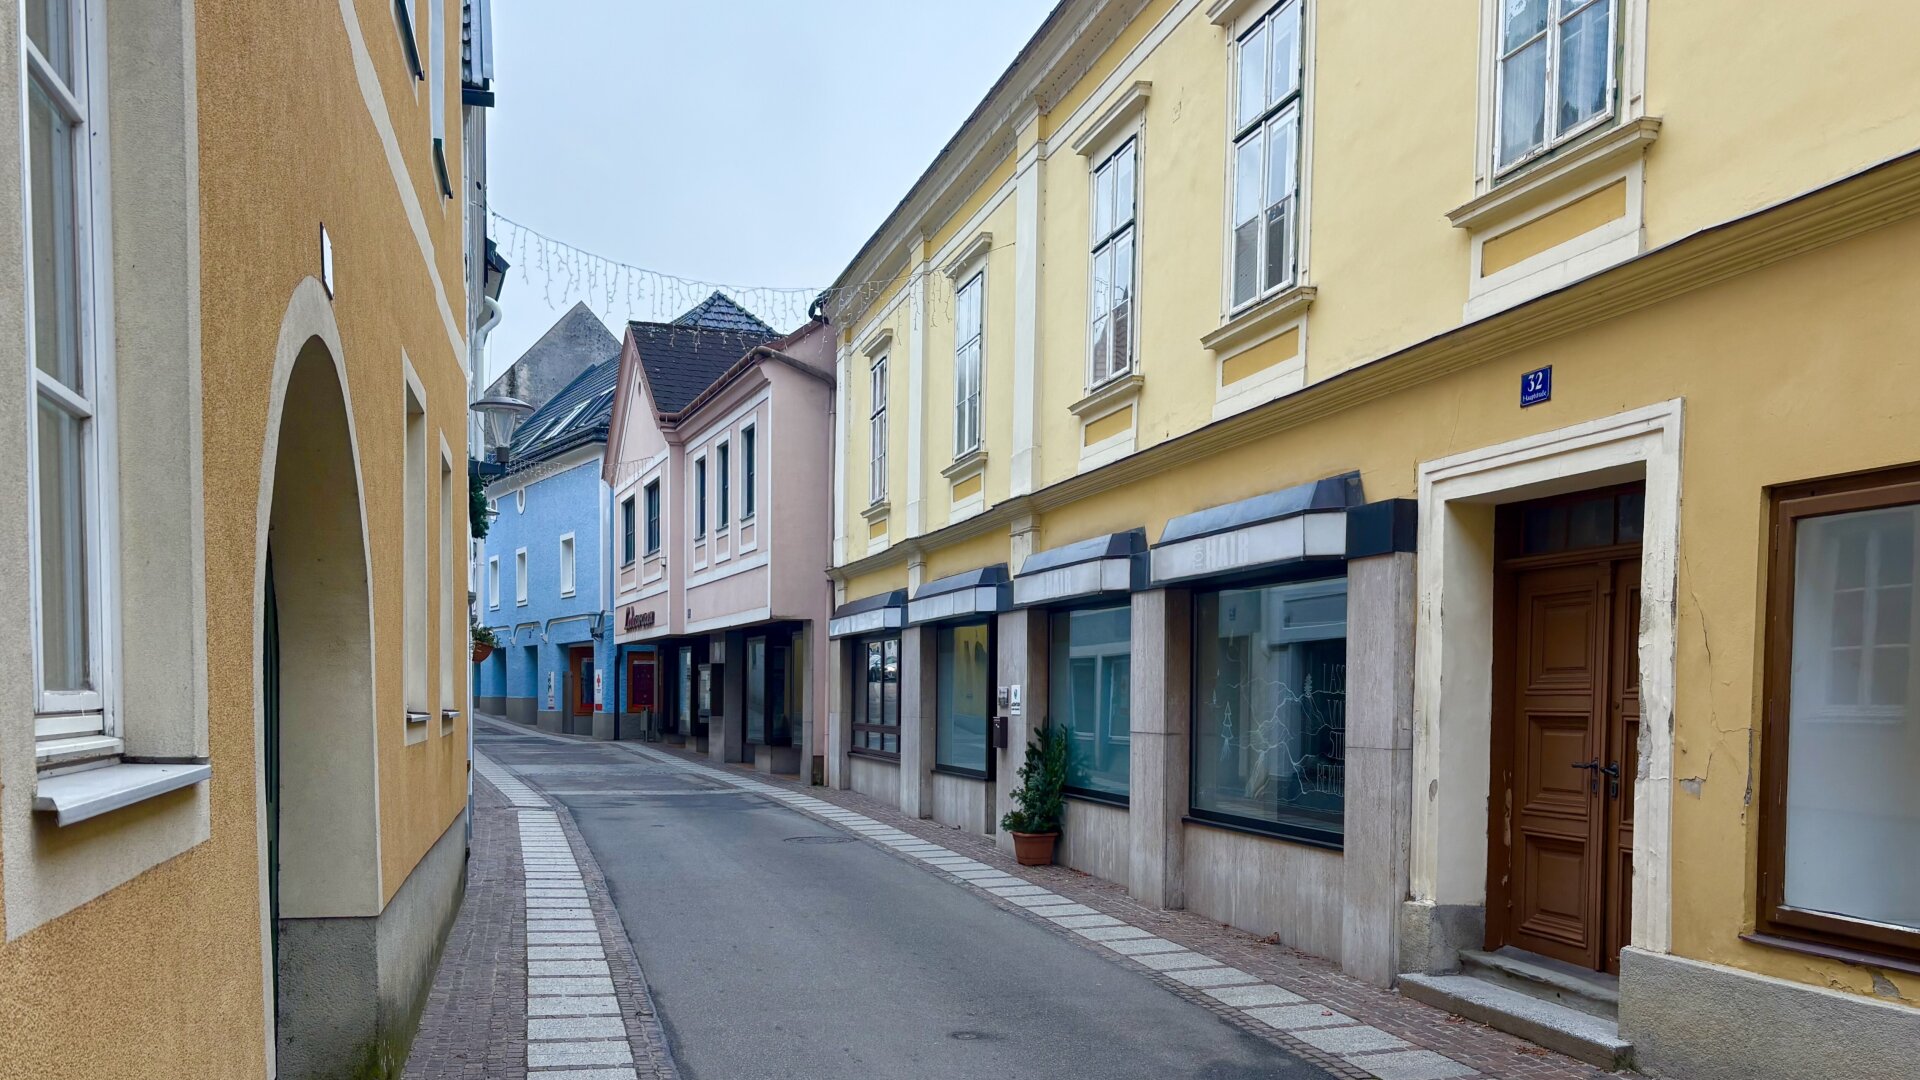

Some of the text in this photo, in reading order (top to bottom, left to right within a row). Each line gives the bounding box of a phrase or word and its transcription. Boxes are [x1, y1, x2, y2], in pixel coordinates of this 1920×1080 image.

[1528, 371, 1543, 392] 32
[1205, 532, 1249, 570] HAIR
[1046, 570, 1072, 597] HAIR
